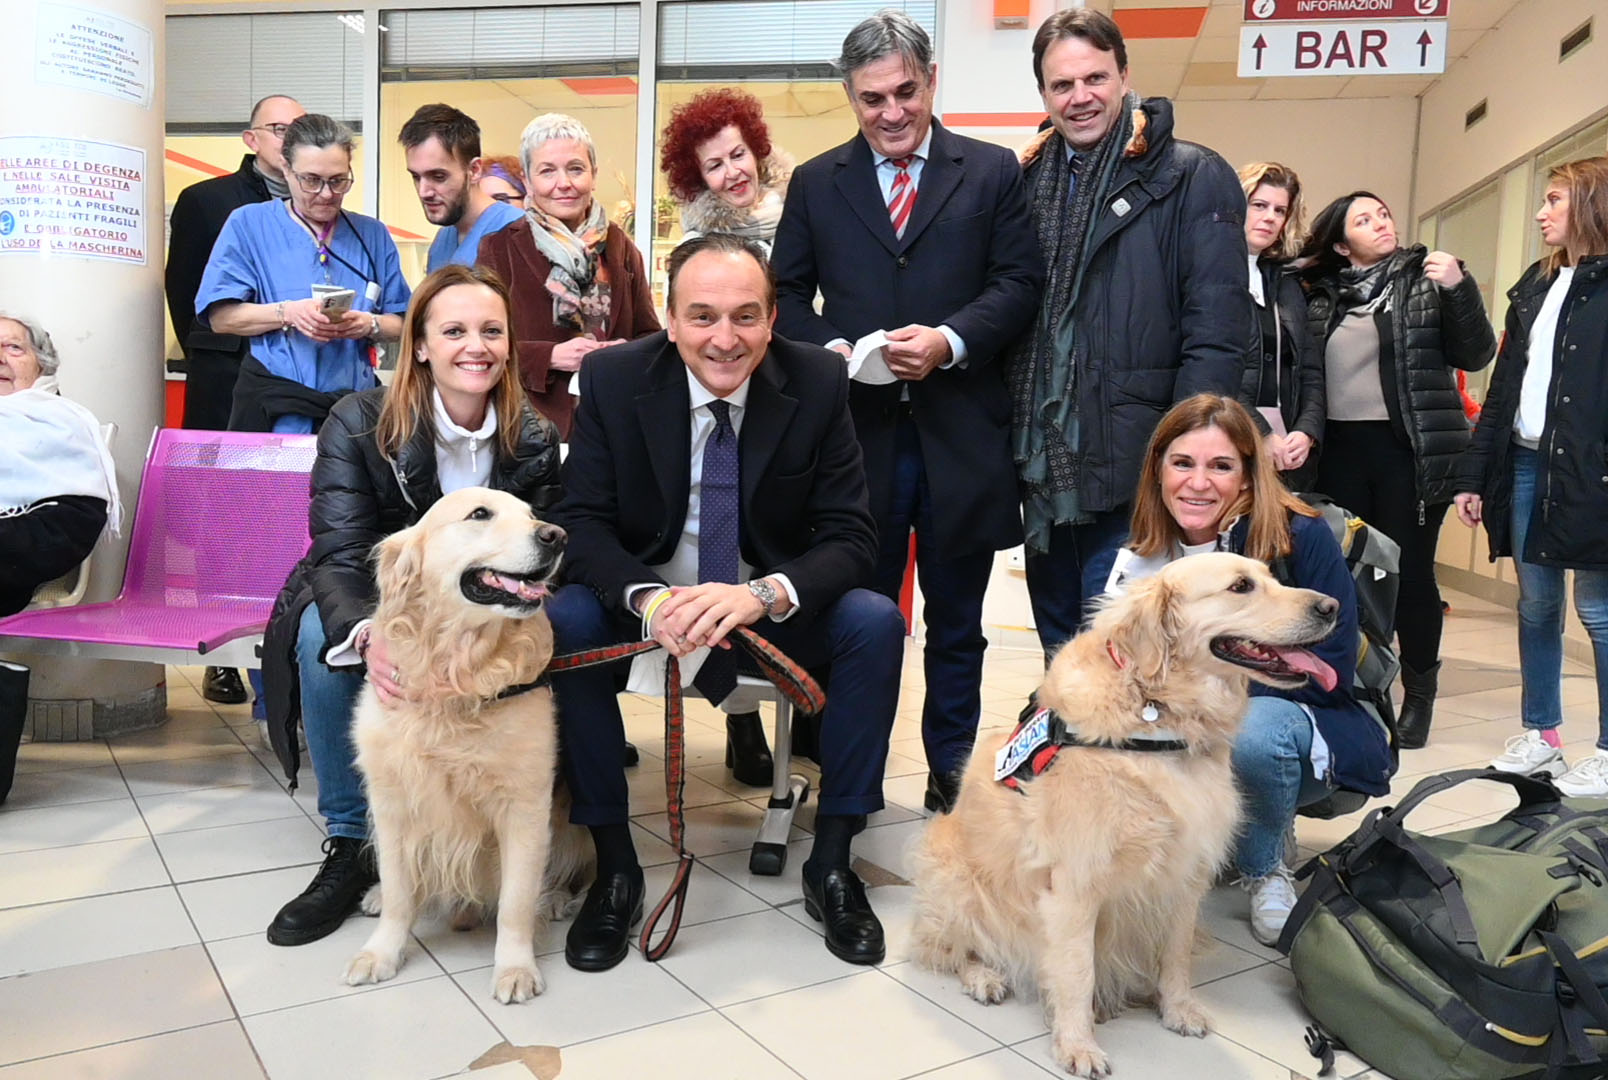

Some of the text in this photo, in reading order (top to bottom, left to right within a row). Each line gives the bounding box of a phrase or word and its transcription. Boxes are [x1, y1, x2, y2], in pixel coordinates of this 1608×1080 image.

[1297, 0, 1393, 12] INFORMAZIONI
[71, 24, 124, 42] ATTENZIONE
[1295, 29, 1388, 70] BAR
[25, 158, 58, 168] AREE
[63, 160, 79, 171] DI
[84, 162, 141, 181] DEGENZA
[12, 171, 42, 181] NELLE
[50, 172, 80, 183] SALE
[89, 175, 130, 190] VISITA
[67, 200, 81, 208] LA
[86, 201, 140, 216] PRESENZA
[19, 209, 137, 228] DI PAZIENTI FRAGILI
[29, 238, 63, 249] DELA
[69, 241, 143, 258] MASCHERINA
